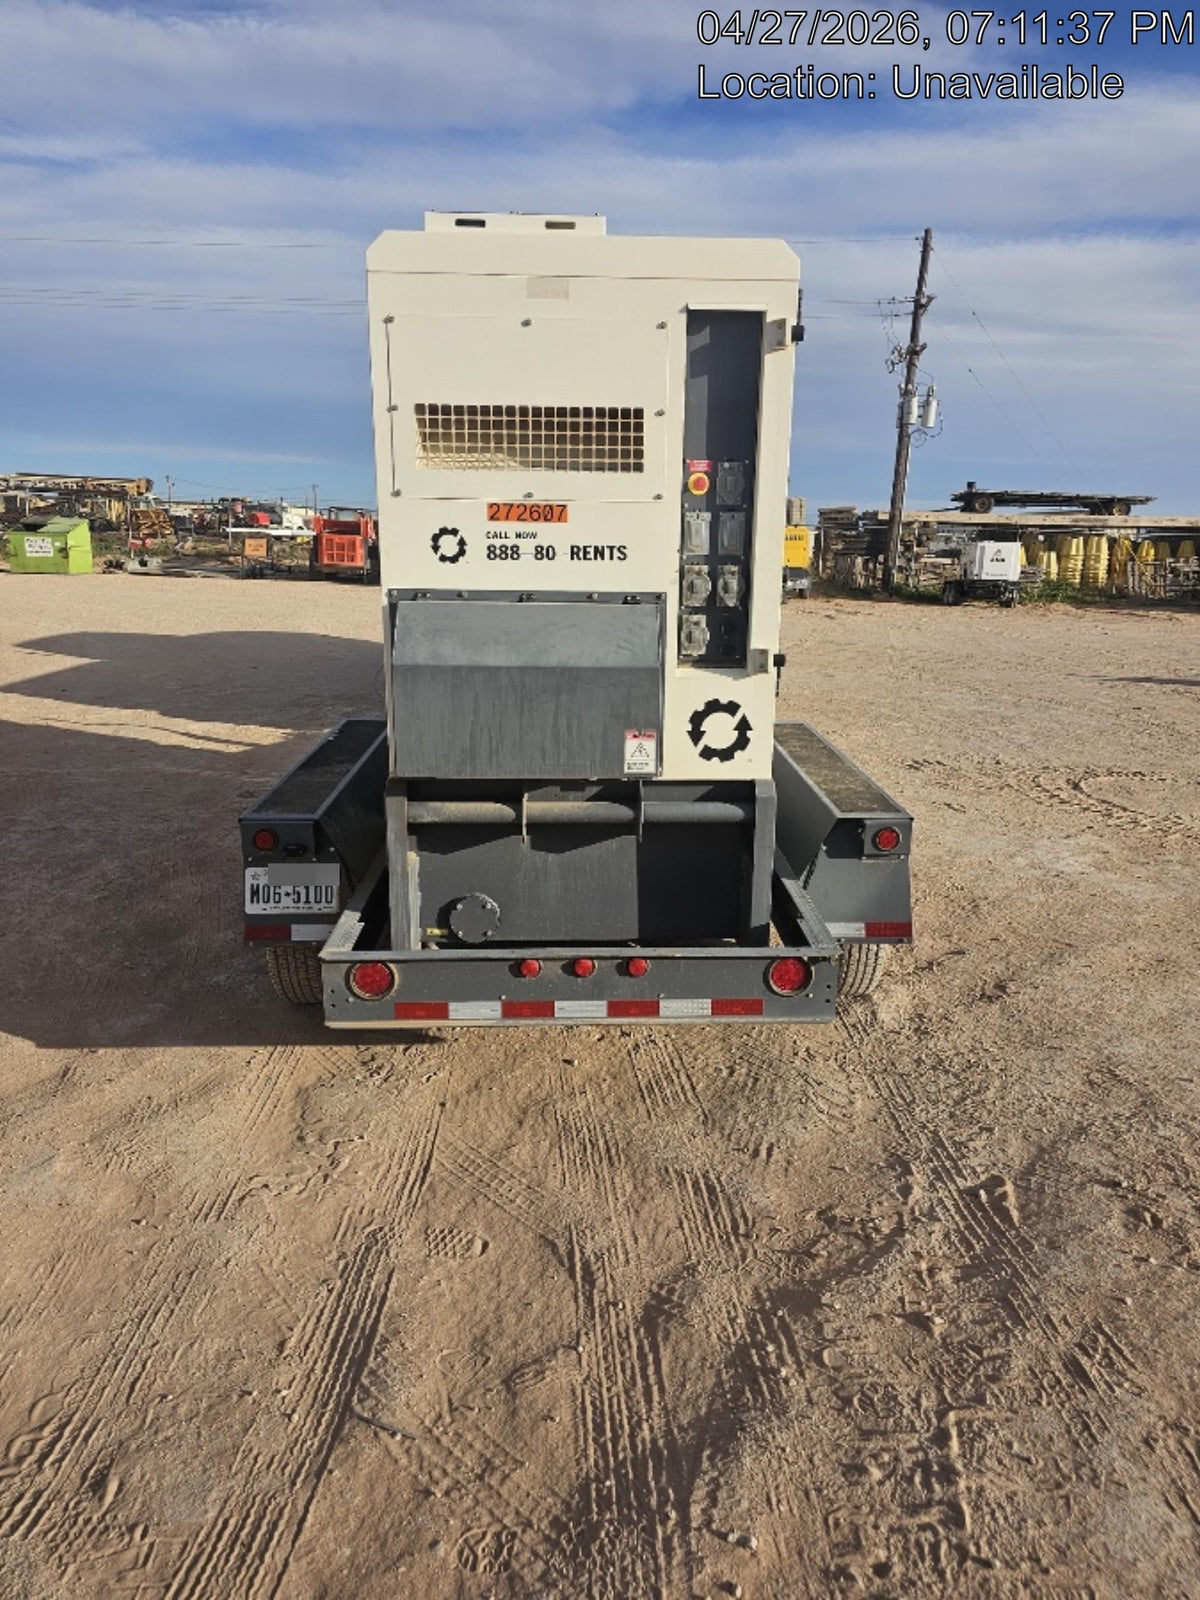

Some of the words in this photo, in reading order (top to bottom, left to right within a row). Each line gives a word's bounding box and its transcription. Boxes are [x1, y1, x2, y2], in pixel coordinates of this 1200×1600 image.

[487, 502, 568, 522] 272607
[486, 531, 510, 539] CALL
[515, 531, 538, 539] NOW
